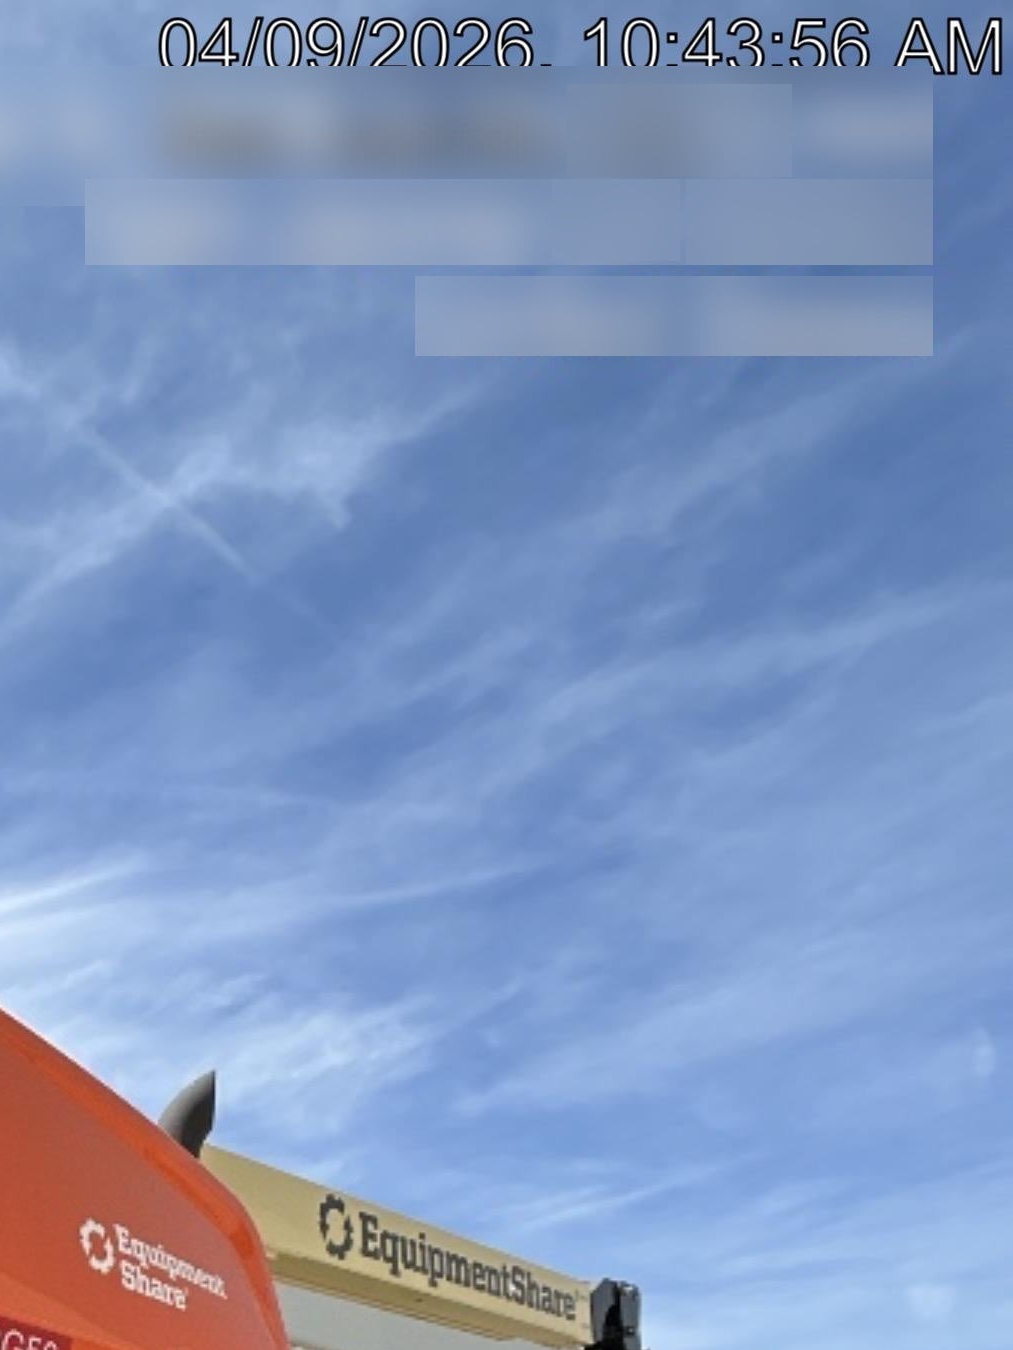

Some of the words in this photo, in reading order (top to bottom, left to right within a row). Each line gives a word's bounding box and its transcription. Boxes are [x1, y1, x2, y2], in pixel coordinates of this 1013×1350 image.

[113, 1223, 229, 1301] Equipment
[119, 1259, 187, 1312] Share
[359, 1211, 576, 1321] EquipmentShare
